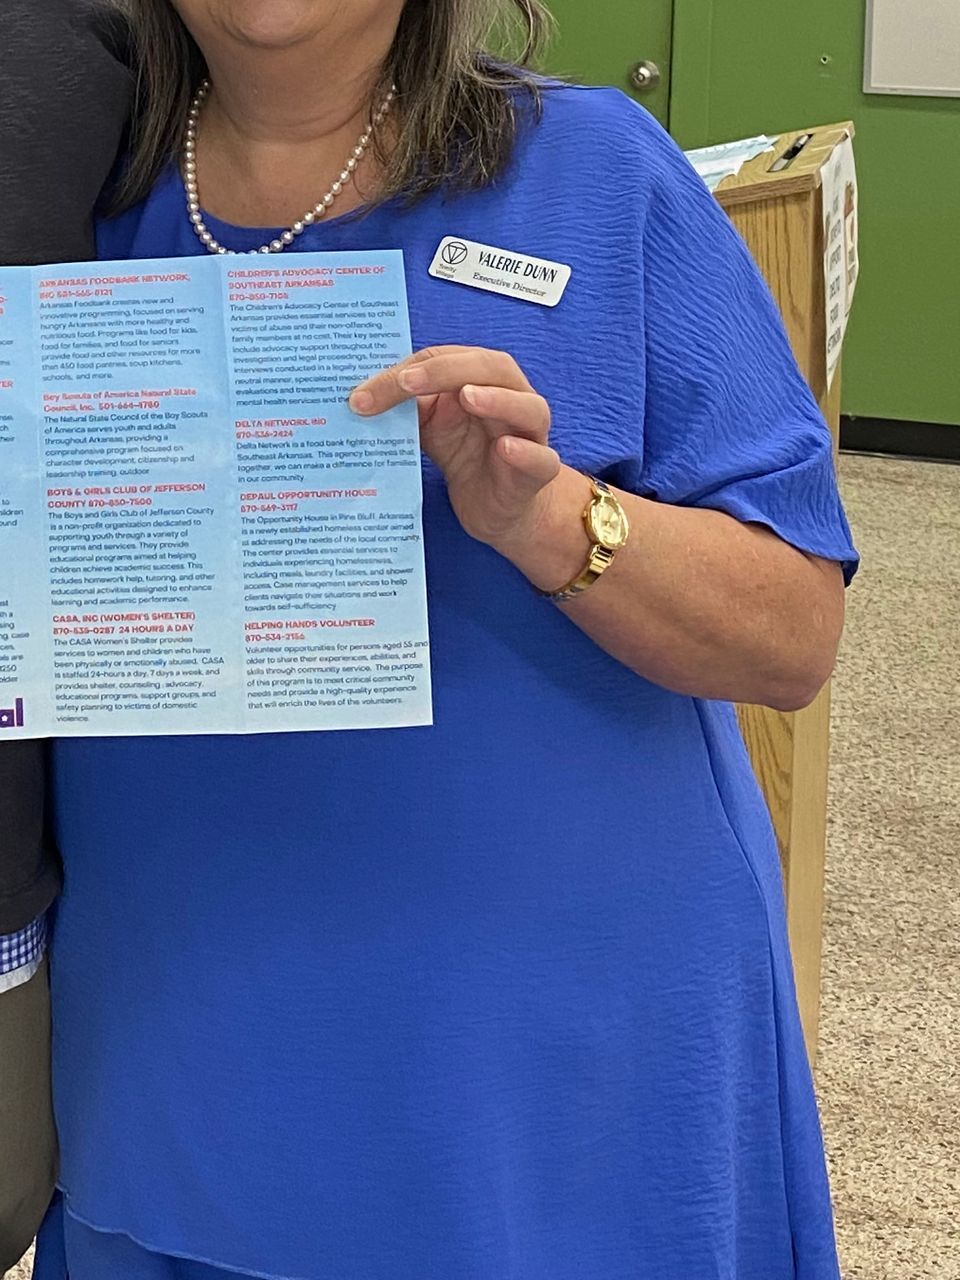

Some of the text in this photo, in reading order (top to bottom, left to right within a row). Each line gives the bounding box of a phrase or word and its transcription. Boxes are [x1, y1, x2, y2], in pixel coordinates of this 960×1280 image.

[478, 251, 558, 283] VALERIE DUNN
[228, 278, 334, 289] SOUTHEAST ARKANSAS
[473, 272, 547, 297] Executive Director
[43, 387, 197, 402] Boy Scouts of America Natural State
[47, 488, 72, 496] BOYS
[84, 486, 111, 495] GIRLS
[113, 485, 137, 494] CLUB
[140, 485, 152, 493] OF
[154, 483, 205, 493] JEFFERSON
[240, 488, 377, 501] DEPAUL OPPORTUNITY HOUSE
[48, 499, 86, 508] COUNTY
[83, 614, 98, 622] INC
[100, 613, 149, 623] (WOMEN'S
[152, 612, 196, 621] SHELTER)
[245, 618, 375, 630] HELPING HANDS VOLUNTEER
[119, 625, 130, 633] 24
[132, 624, 164, 633] HOURS
[166, 624, 173, 632] A
[175, 624, 194, 632] DAY
[55, 660, 74, 668] been
[76, 659, 112, 669] physically
[124, 658, 166, 668] emotionally
[202, 656, 224, 664] CASA
